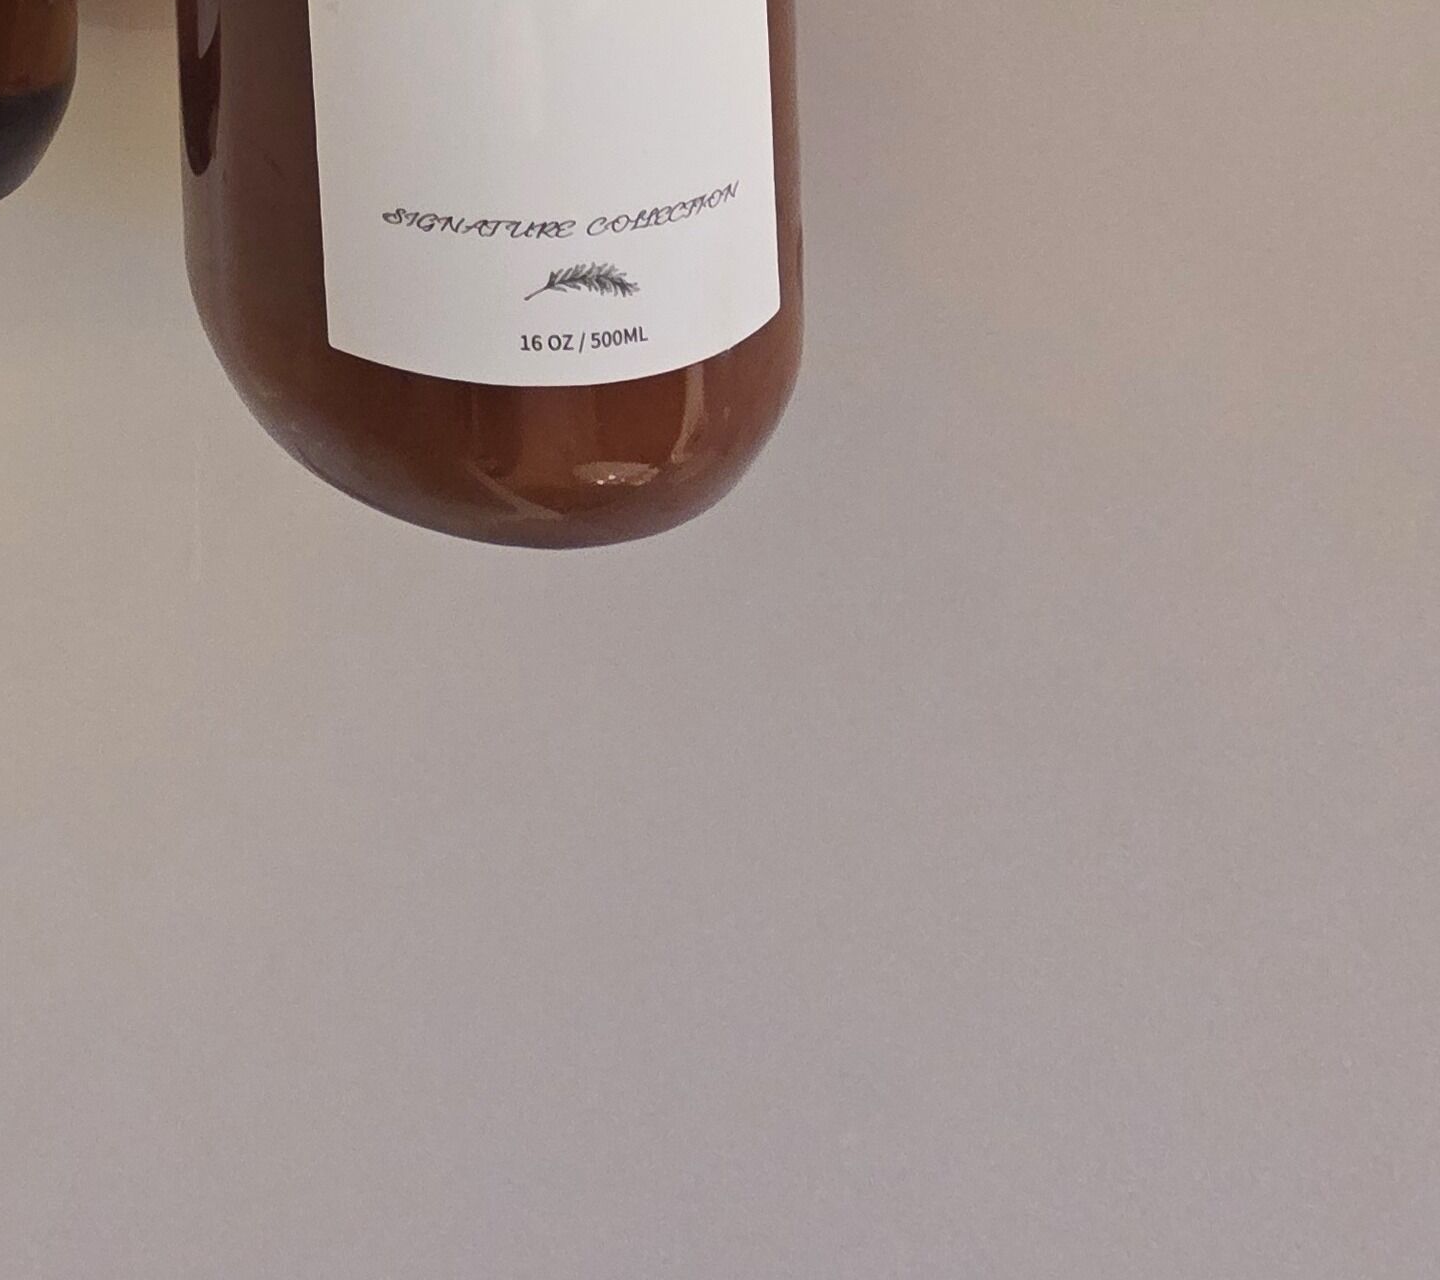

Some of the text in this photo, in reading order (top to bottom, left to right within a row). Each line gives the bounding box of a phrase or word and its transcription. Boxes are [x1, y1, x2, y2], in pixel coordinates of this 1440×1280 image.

[381, 180, 740, 240] SIGNATURE COLLECTION
[520, 325, 649, 354] 16 OZ / 500ML
